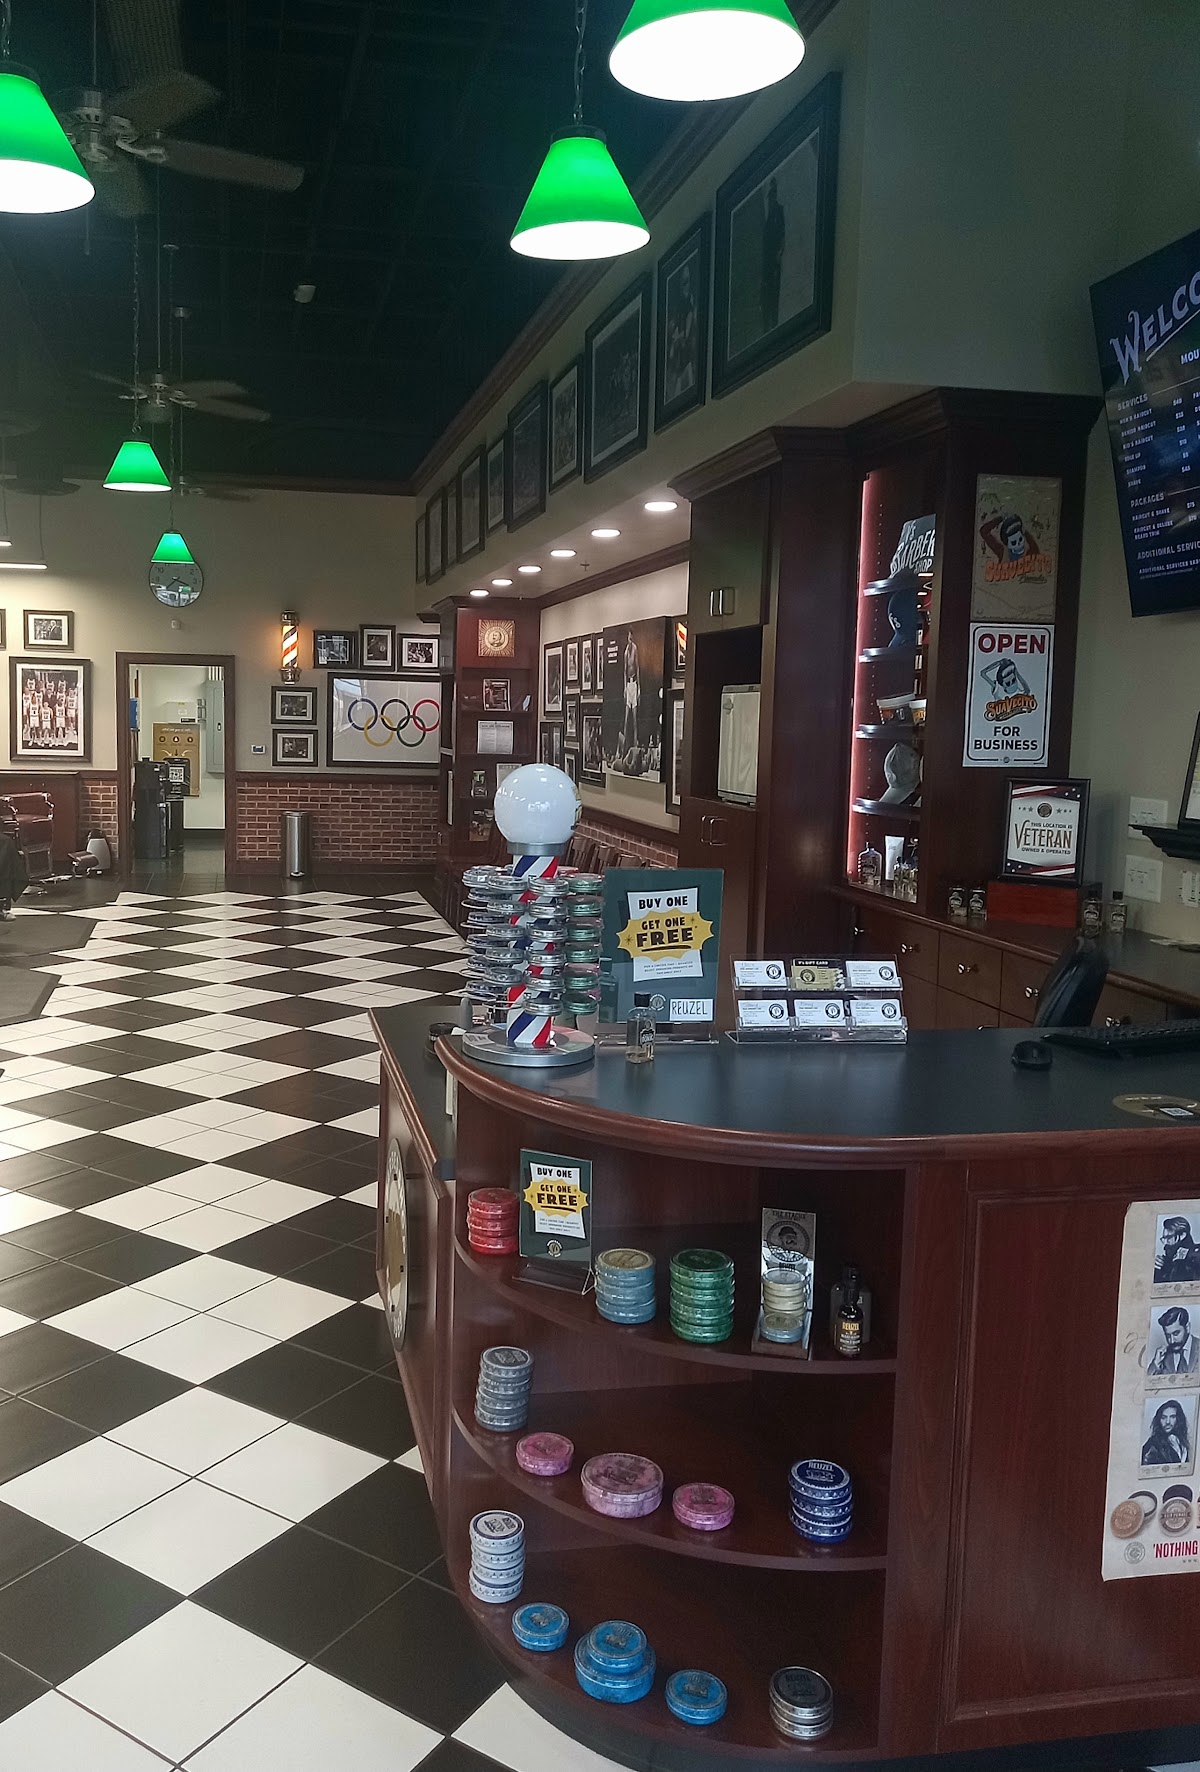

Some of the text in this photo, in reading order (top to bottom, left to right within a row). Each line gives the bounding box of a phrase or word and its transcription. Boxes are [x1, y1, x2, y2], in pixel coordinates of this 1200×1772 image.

[1118, 393, 1148, 411] SERVICES
[1130, 493, 1164, 508] PACKAGES
[1137, 546, 1175, 559] ADDITIONAL
[978, 633, 1046, 654] OPEN
[984, 696, 1038, 720] SUAVECITO
[994, 726, 1021, 737] FOR
[974, 740, 1038, 751] BUSINESS
[1014, 820, 1072, 849] VETERAN
[638, 896, 688, 909] BUY ONE
[642, 917, 685, 930] GET ONE
[636, 928, 693, 948] FREE
[672, 1001, 708, 1015] REUZEL
[537, 1168, 572, 1178] BUY ONE
[540, 1184, 554, 1192] GET
[537, 1193, 577, 1206] FREE
[808, 1462, 834, 1471] REUZEL
